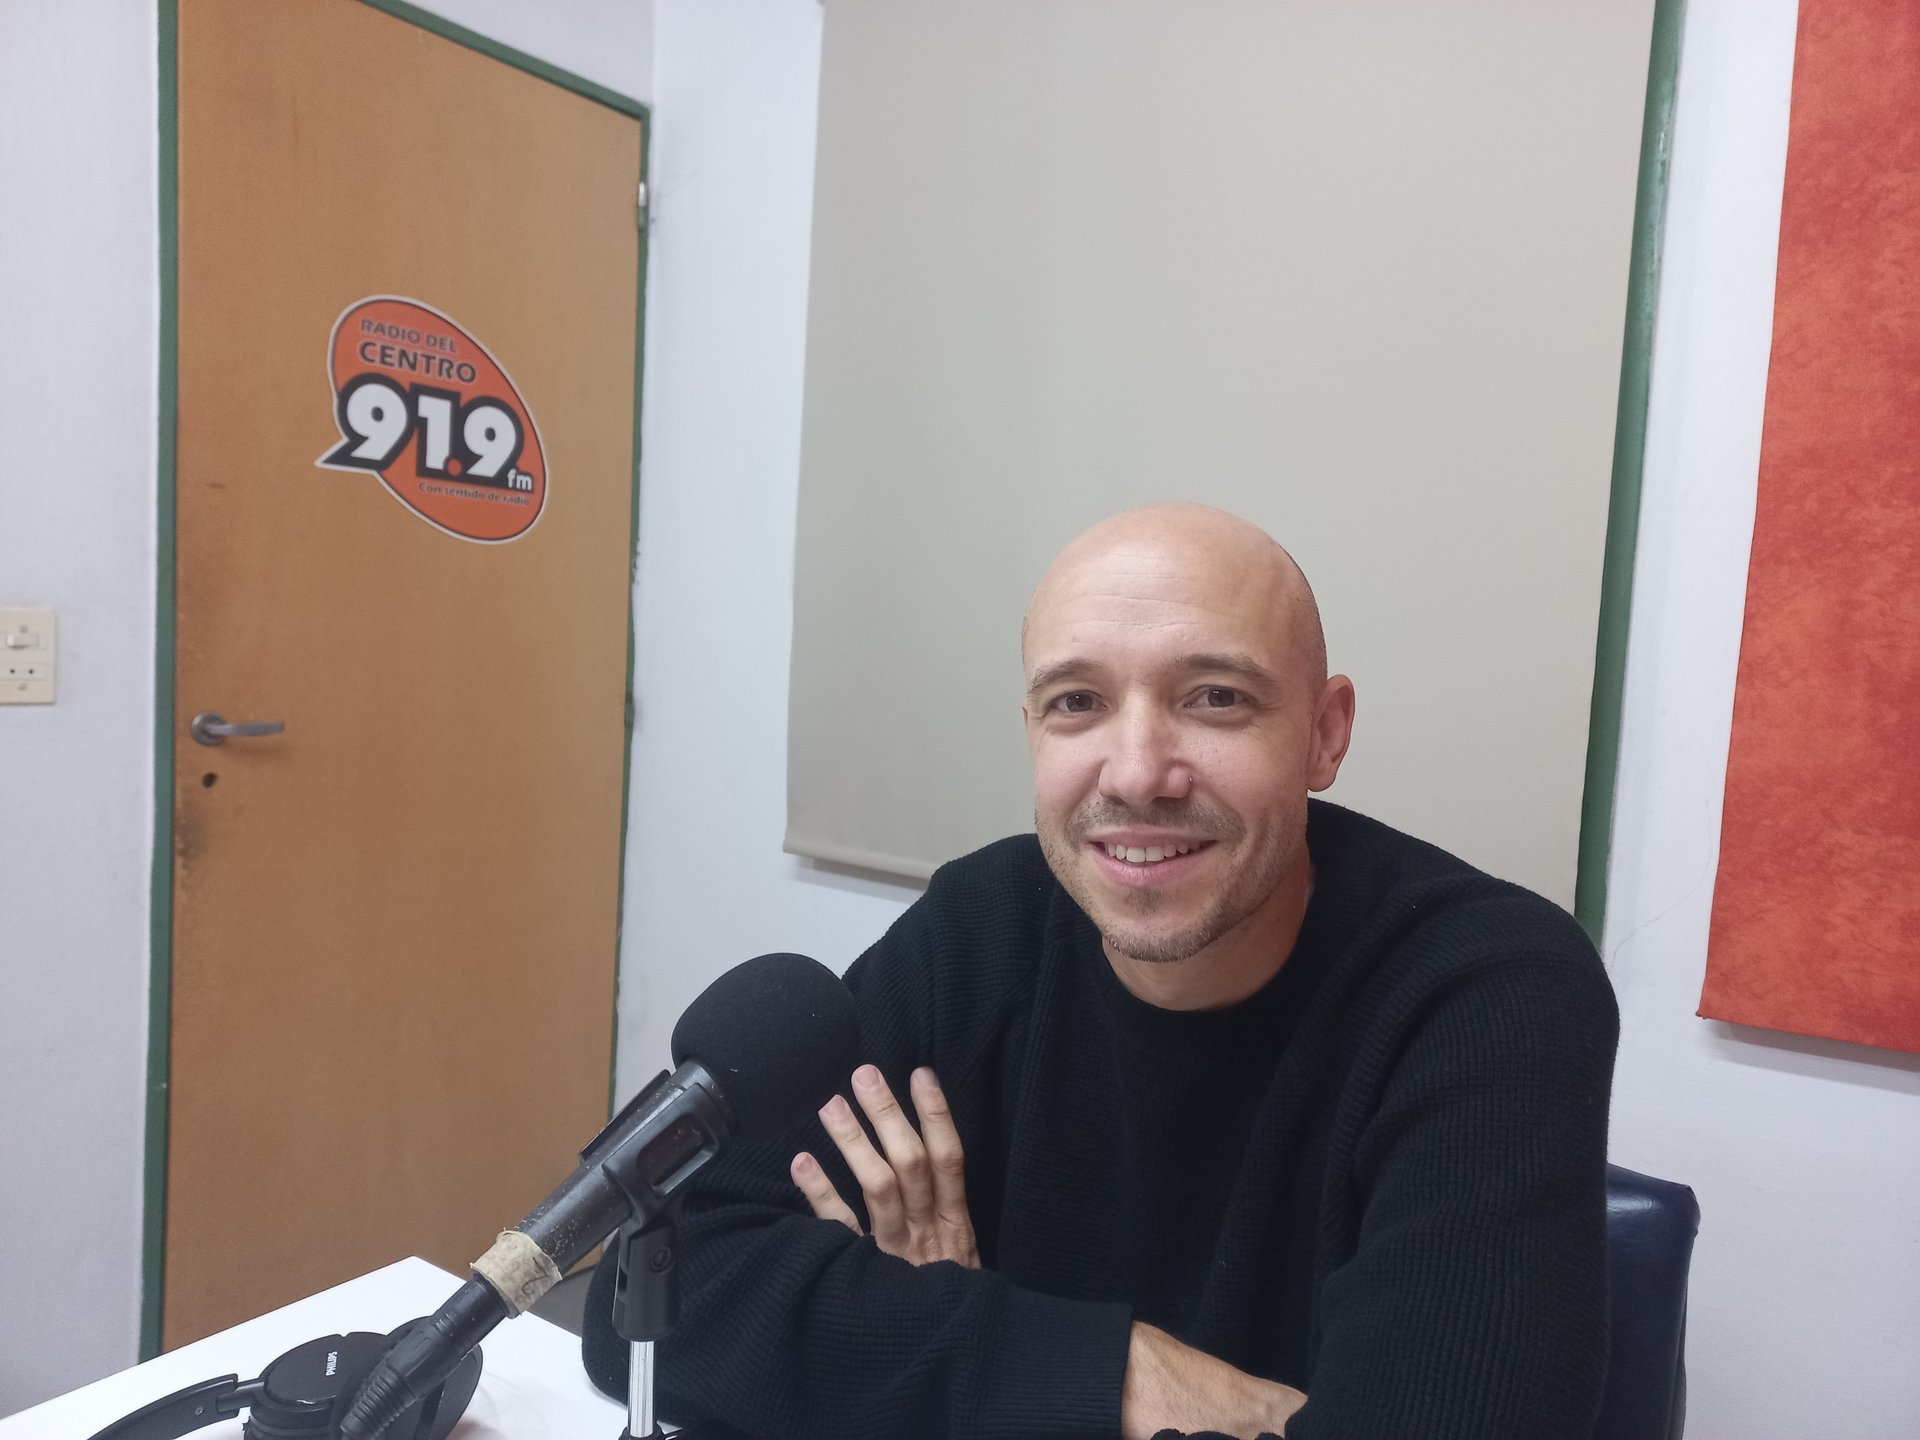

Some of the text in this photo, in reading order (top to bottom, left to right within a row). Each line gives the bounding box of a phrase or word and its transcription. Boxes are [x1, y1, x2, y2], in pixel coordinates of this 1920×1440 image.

[361, 319, 457, 353] RADIO DEL
[359, 341, 476, 384] CENTRO
[347, 383, 532, 491] 91.9 fm
[419, 483, 530, 506] Con sentido de radio
[325, 1351, 338, 1376] PHILIPS
